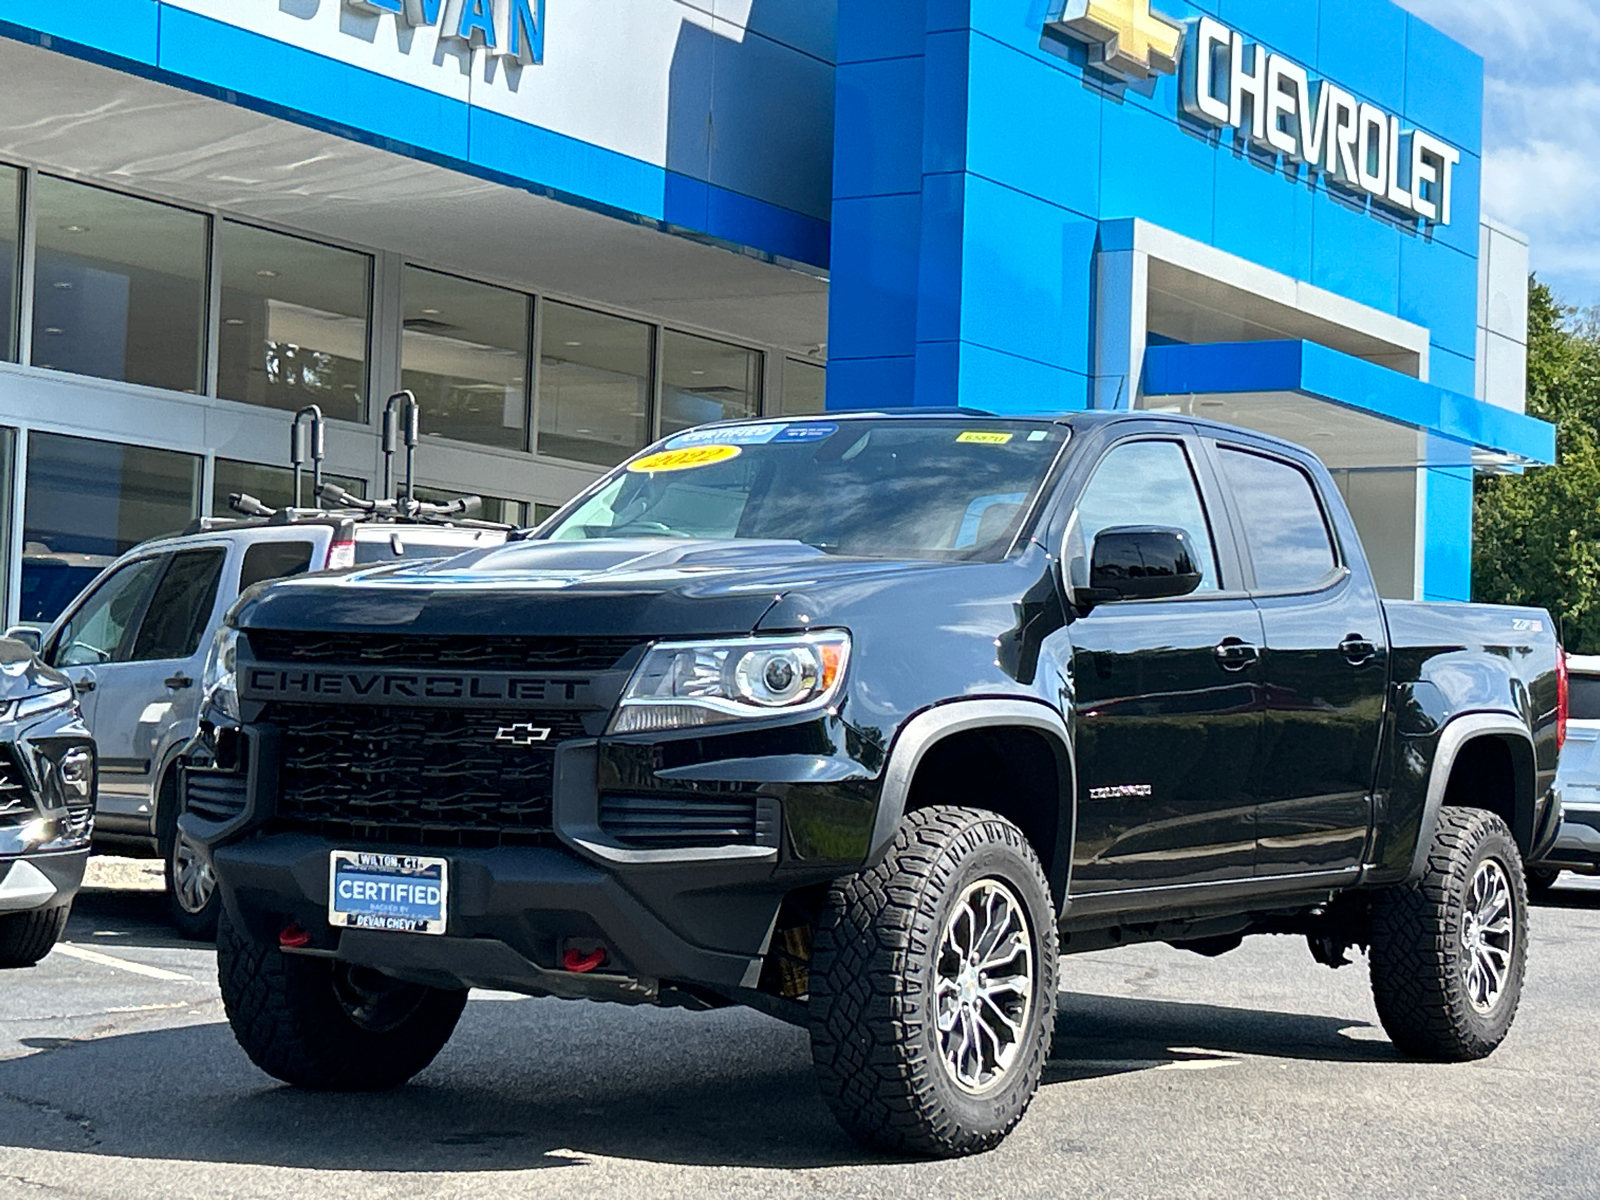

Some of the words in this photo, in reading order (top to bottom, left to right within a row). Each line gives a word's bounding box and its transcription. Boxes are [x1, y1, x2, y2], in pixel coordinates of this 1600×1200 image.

[366, 0, 544, 66] AN
[1197, 16, 1460, 226] CHEVROLET
[250, 670, 591, 700] CHEVROLET
[339, 880, 440, 905] CERTIFIED
[357, 914, 385, 928] DEVAN
[386, 918, 417, 930] CHEVY
